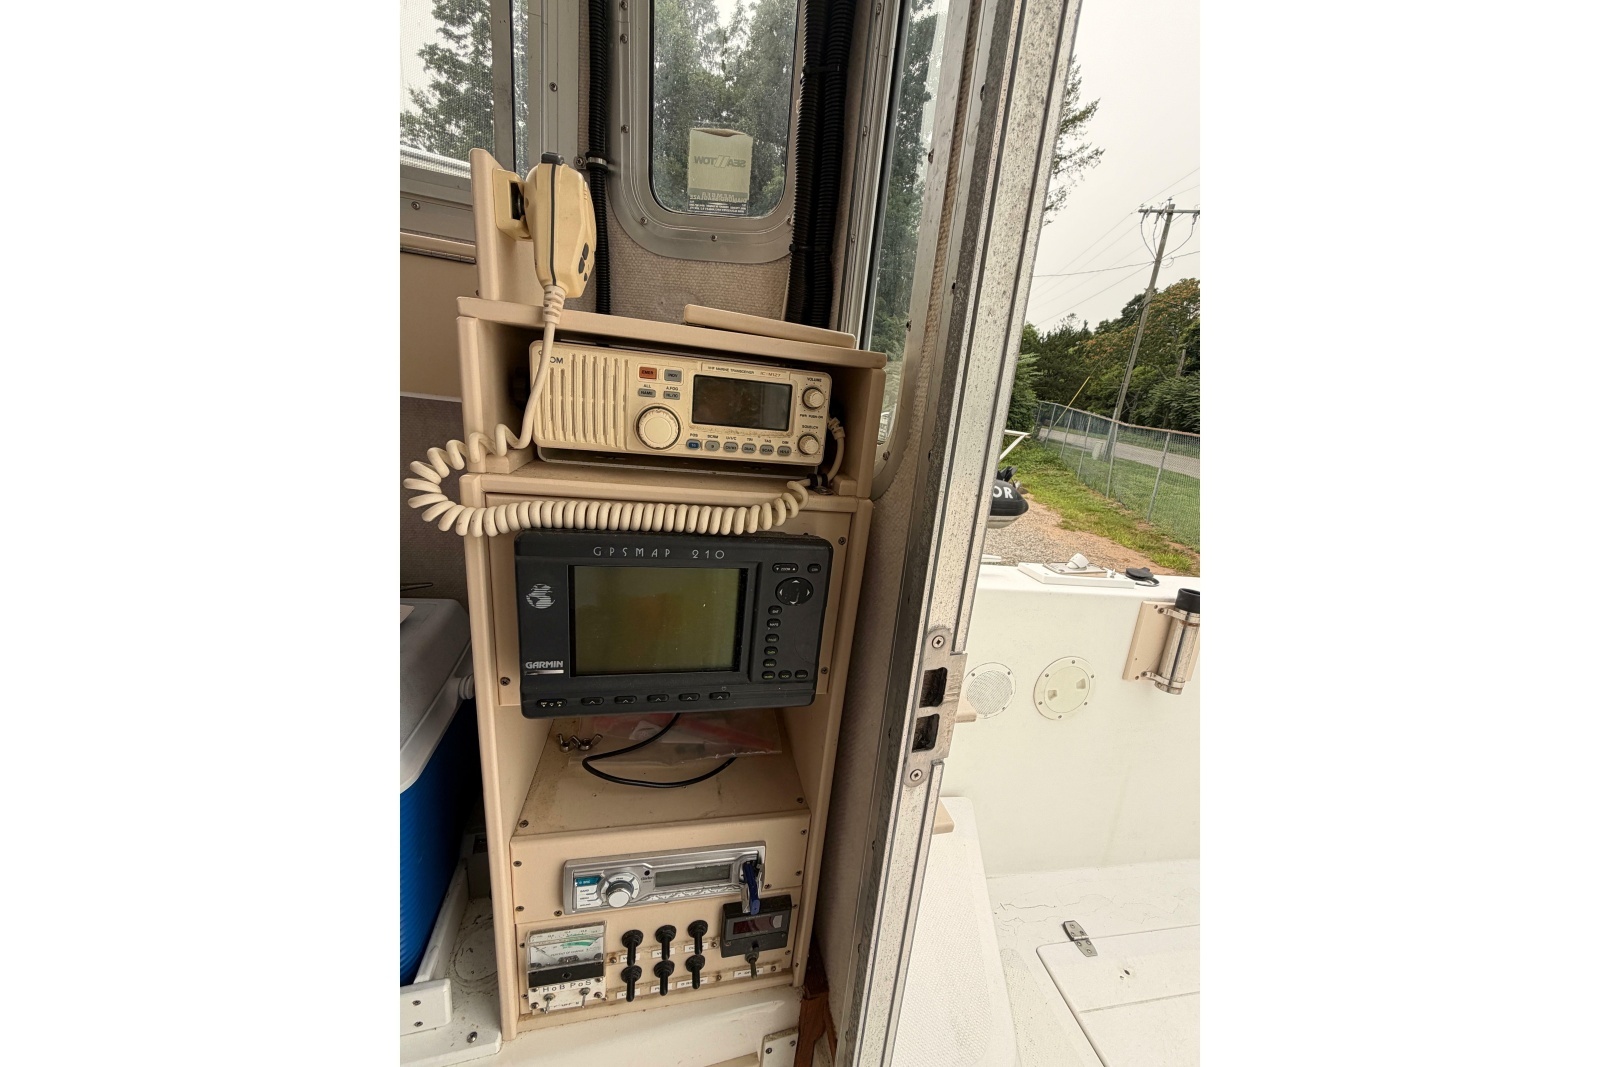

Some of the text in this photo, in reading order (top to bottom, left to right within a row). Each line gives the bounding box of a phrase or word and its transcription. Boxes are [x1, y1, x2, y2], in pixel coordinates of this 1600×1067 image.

[549, 356, 564, 364] OM
[593, 546, 725, 559] GPSMAP 210
[525, 660, 564, 669] GARMIN
